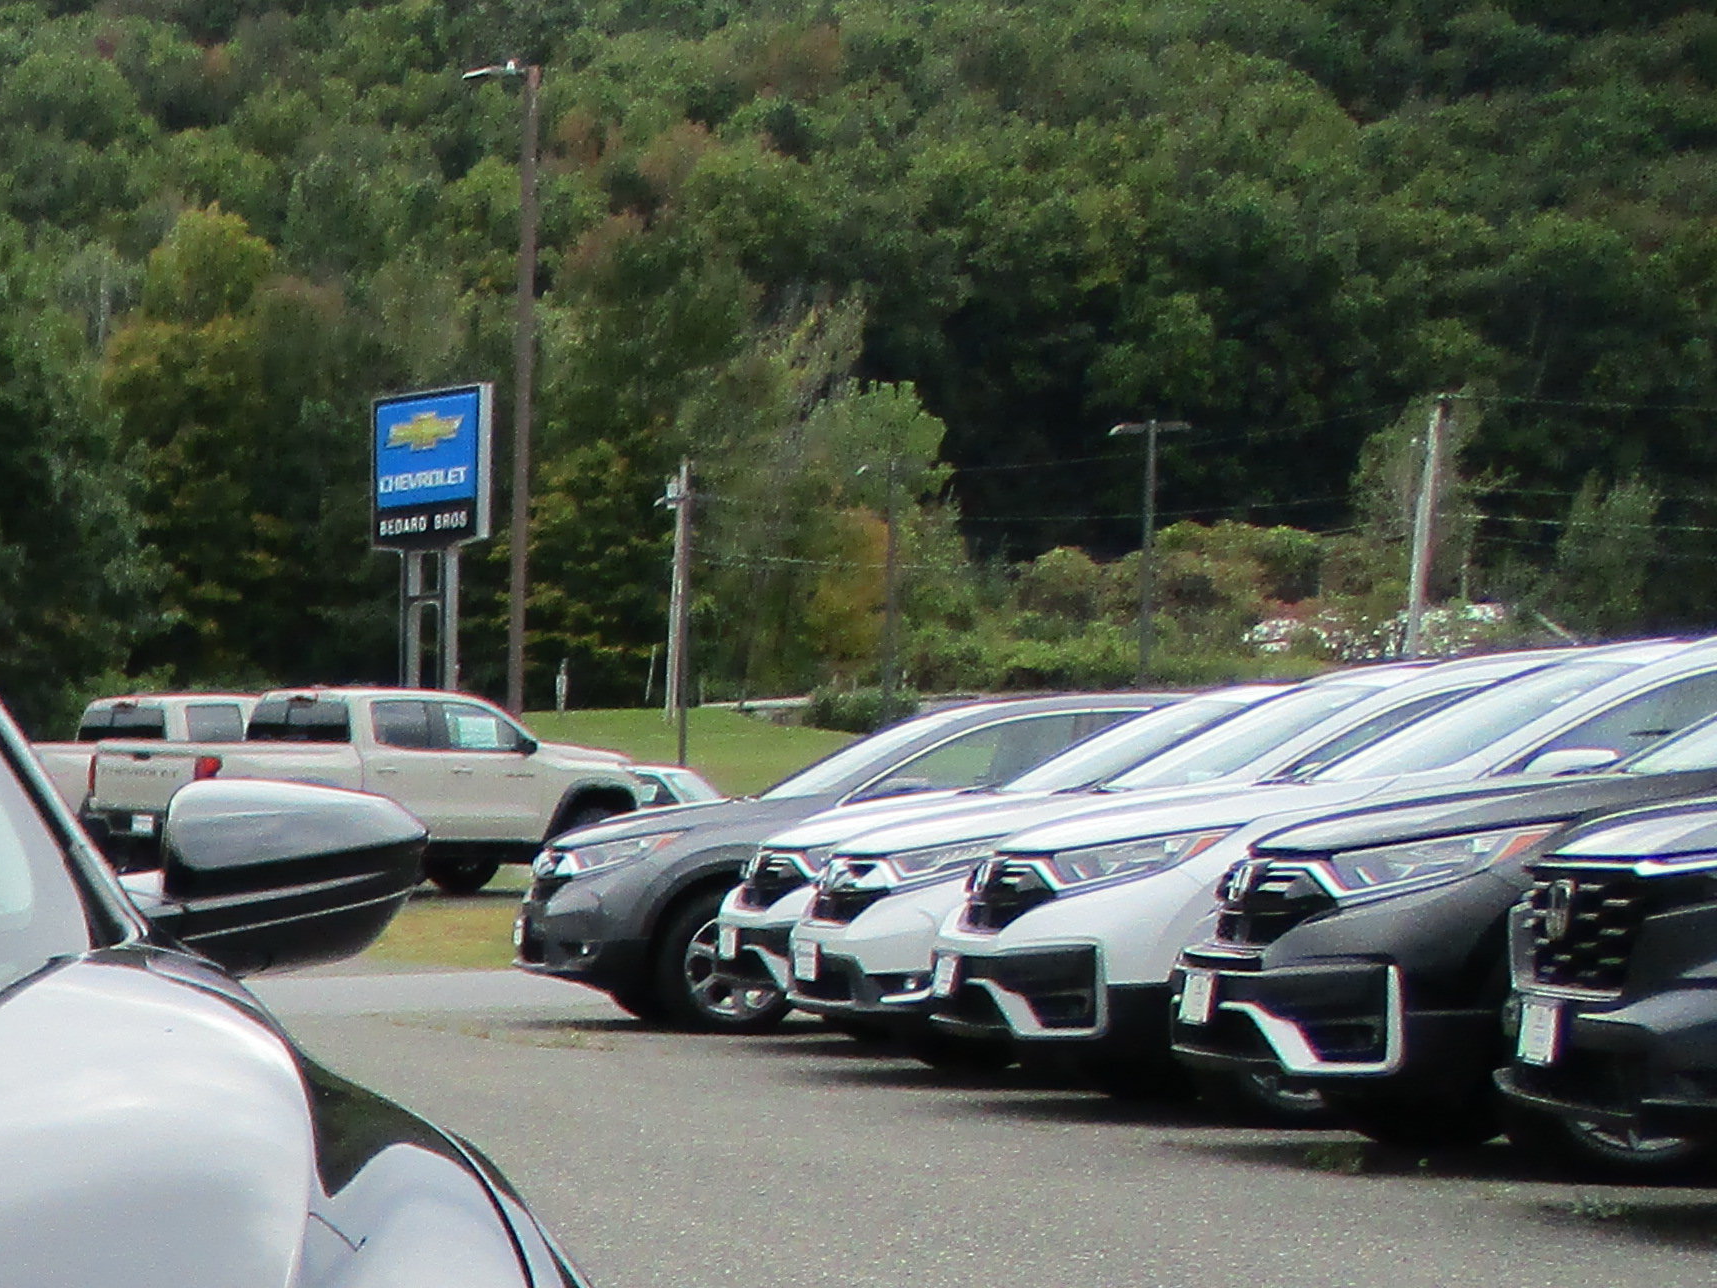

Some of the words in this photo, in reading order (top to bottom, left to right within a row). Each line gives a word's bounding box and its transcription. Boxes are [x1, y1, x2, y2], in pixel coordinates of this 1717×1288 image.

[379, 467, 467, 493] CHEVROLET
[379, 517, 427, 536] BEDARD
[434, 511, 468, 529] BROS
